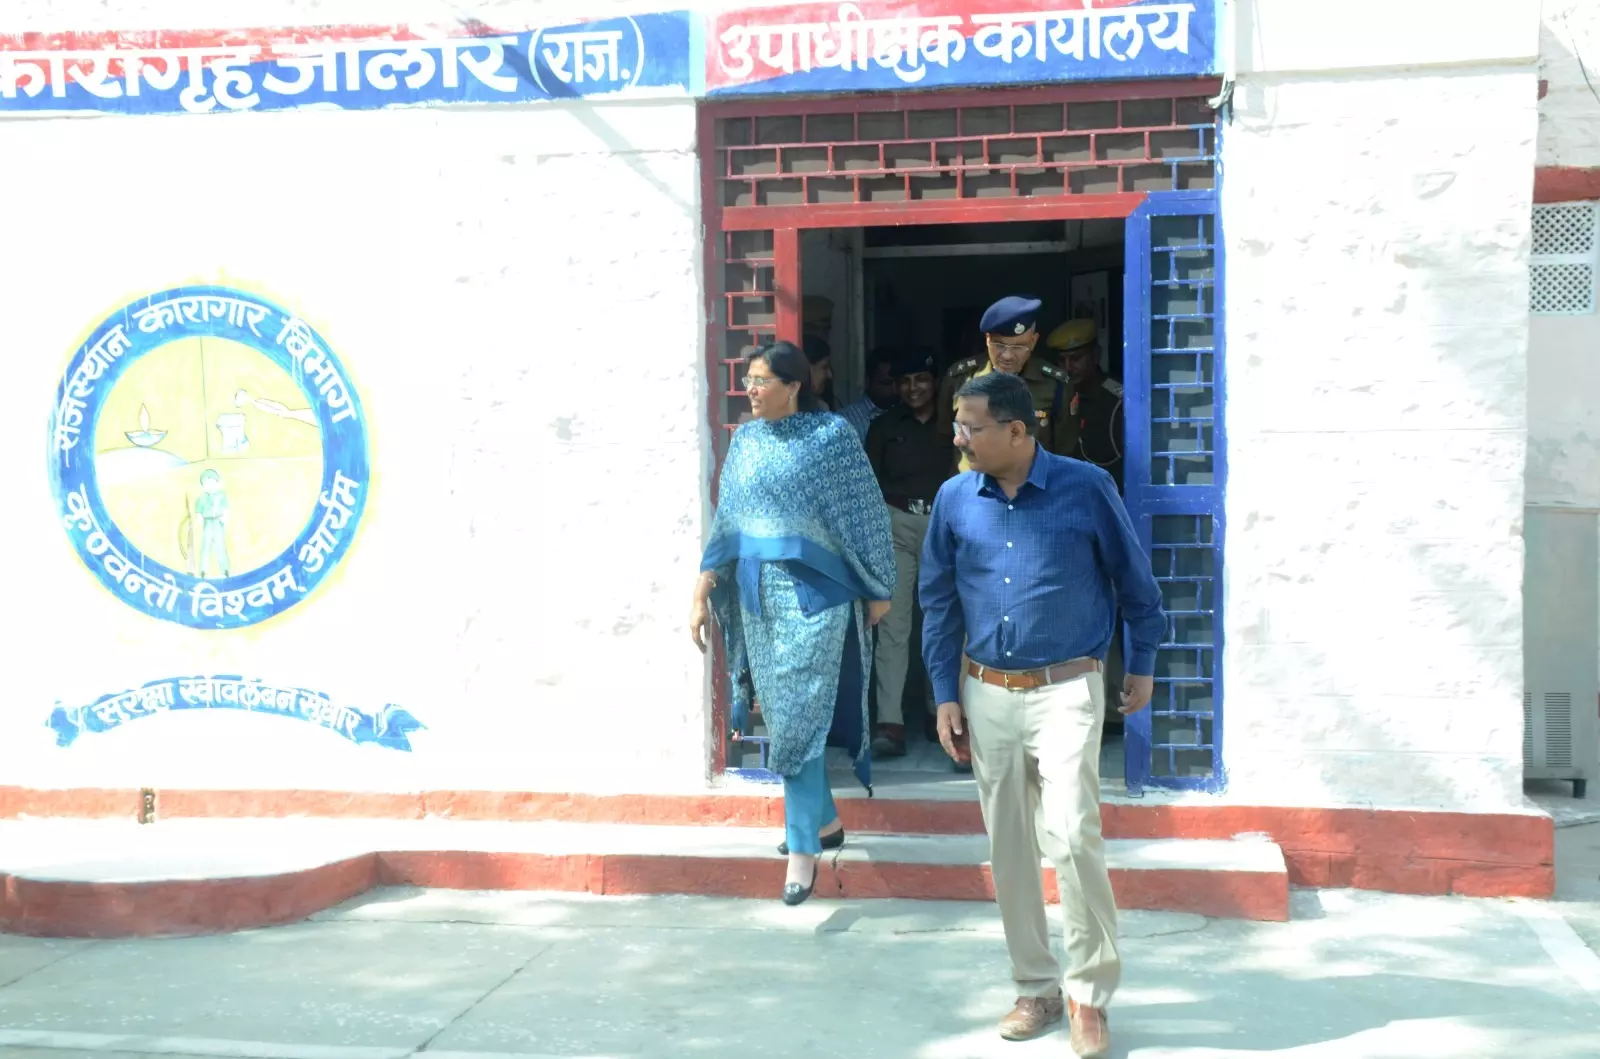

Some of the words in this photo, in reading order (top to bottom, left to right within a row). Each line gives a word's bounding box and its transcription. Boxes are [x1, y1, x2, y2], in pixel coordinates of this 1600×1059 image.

[528, 15, 644, 94] (राज.)
[718, 3, 965, 83] उपाधीक्षक
[970, 0, 1196, 63] कार्यालय
[55, 323, 134, 452] राजस्थान
[132, 295, 273, 339] कारागार
